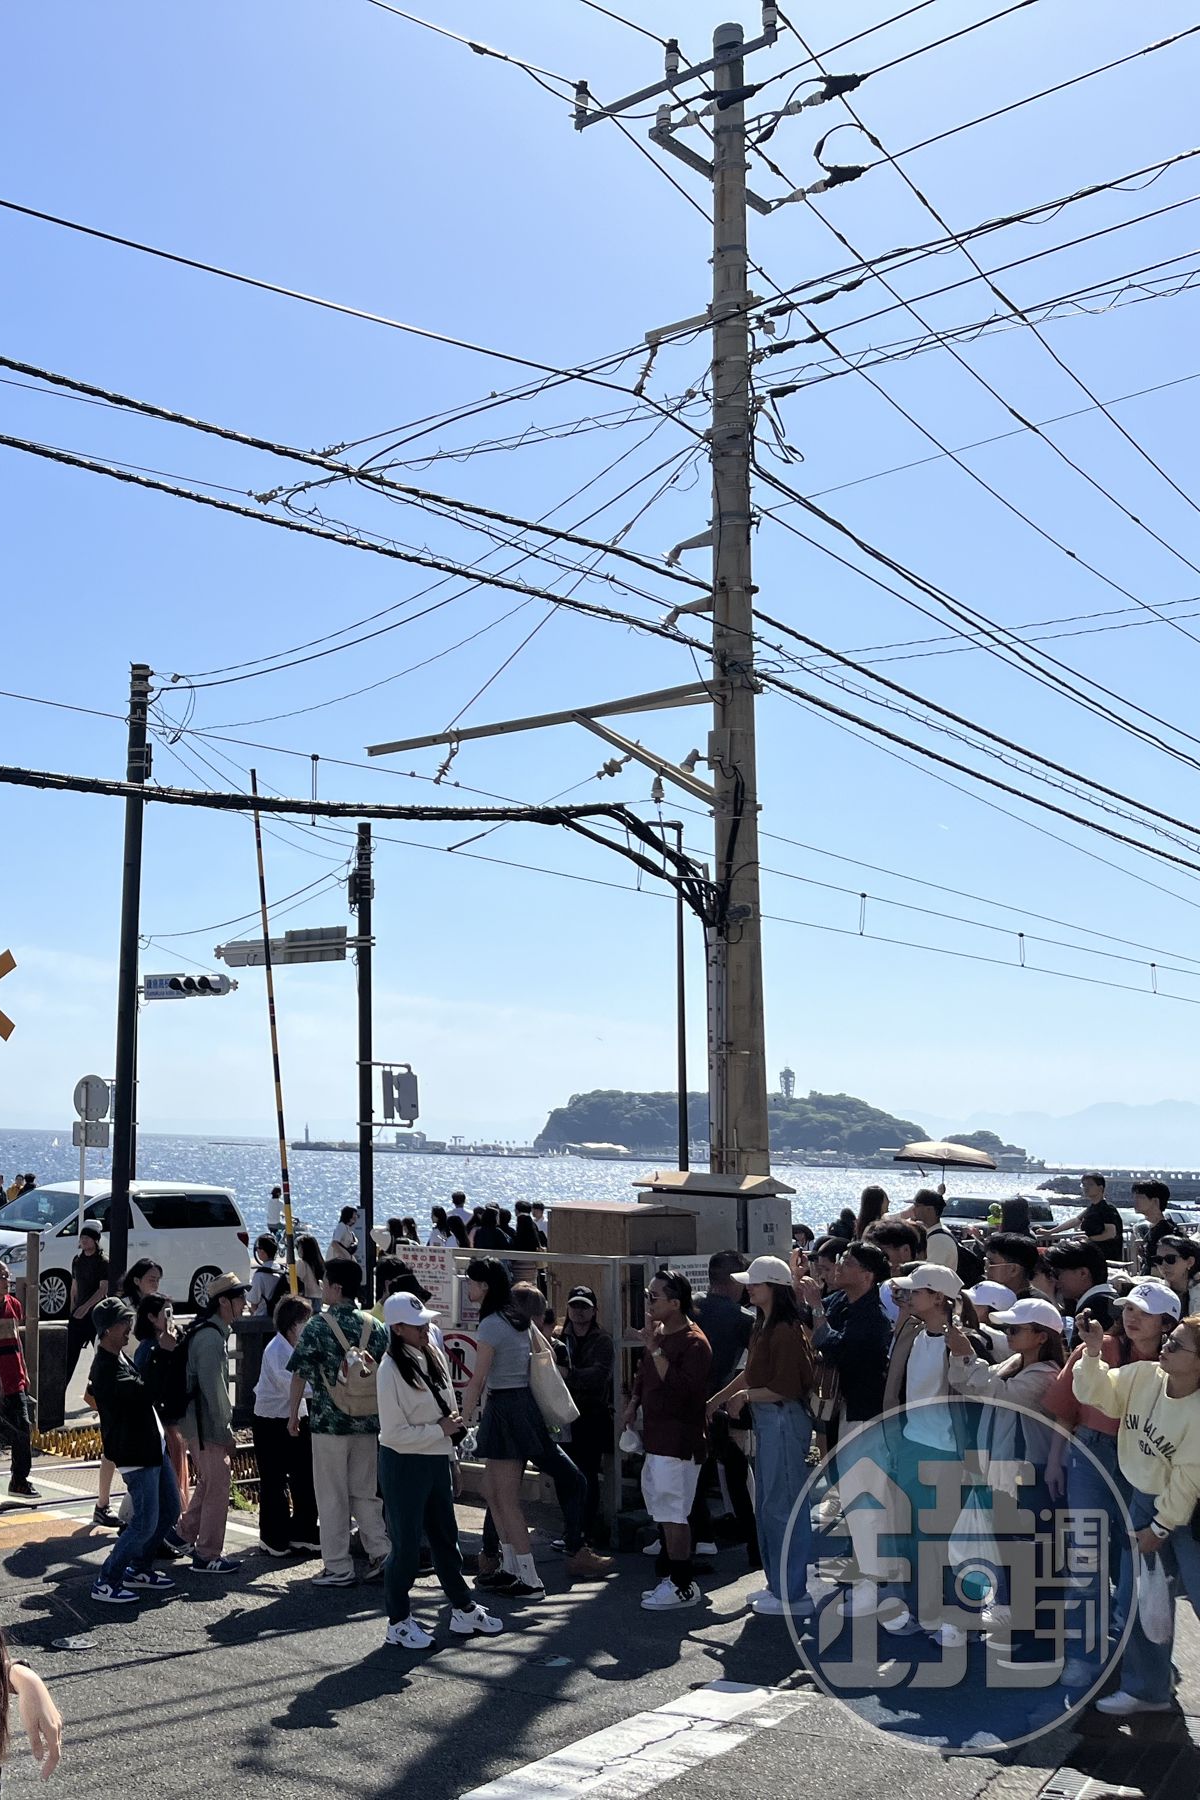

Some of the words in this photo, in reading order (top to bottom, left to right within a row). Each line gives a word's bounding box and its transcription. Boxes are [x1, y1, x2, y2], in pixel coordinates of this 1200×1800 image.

[406, 1261, 446, 1271] のボタンを
[1125, 1413, 1140, 1430] EW
